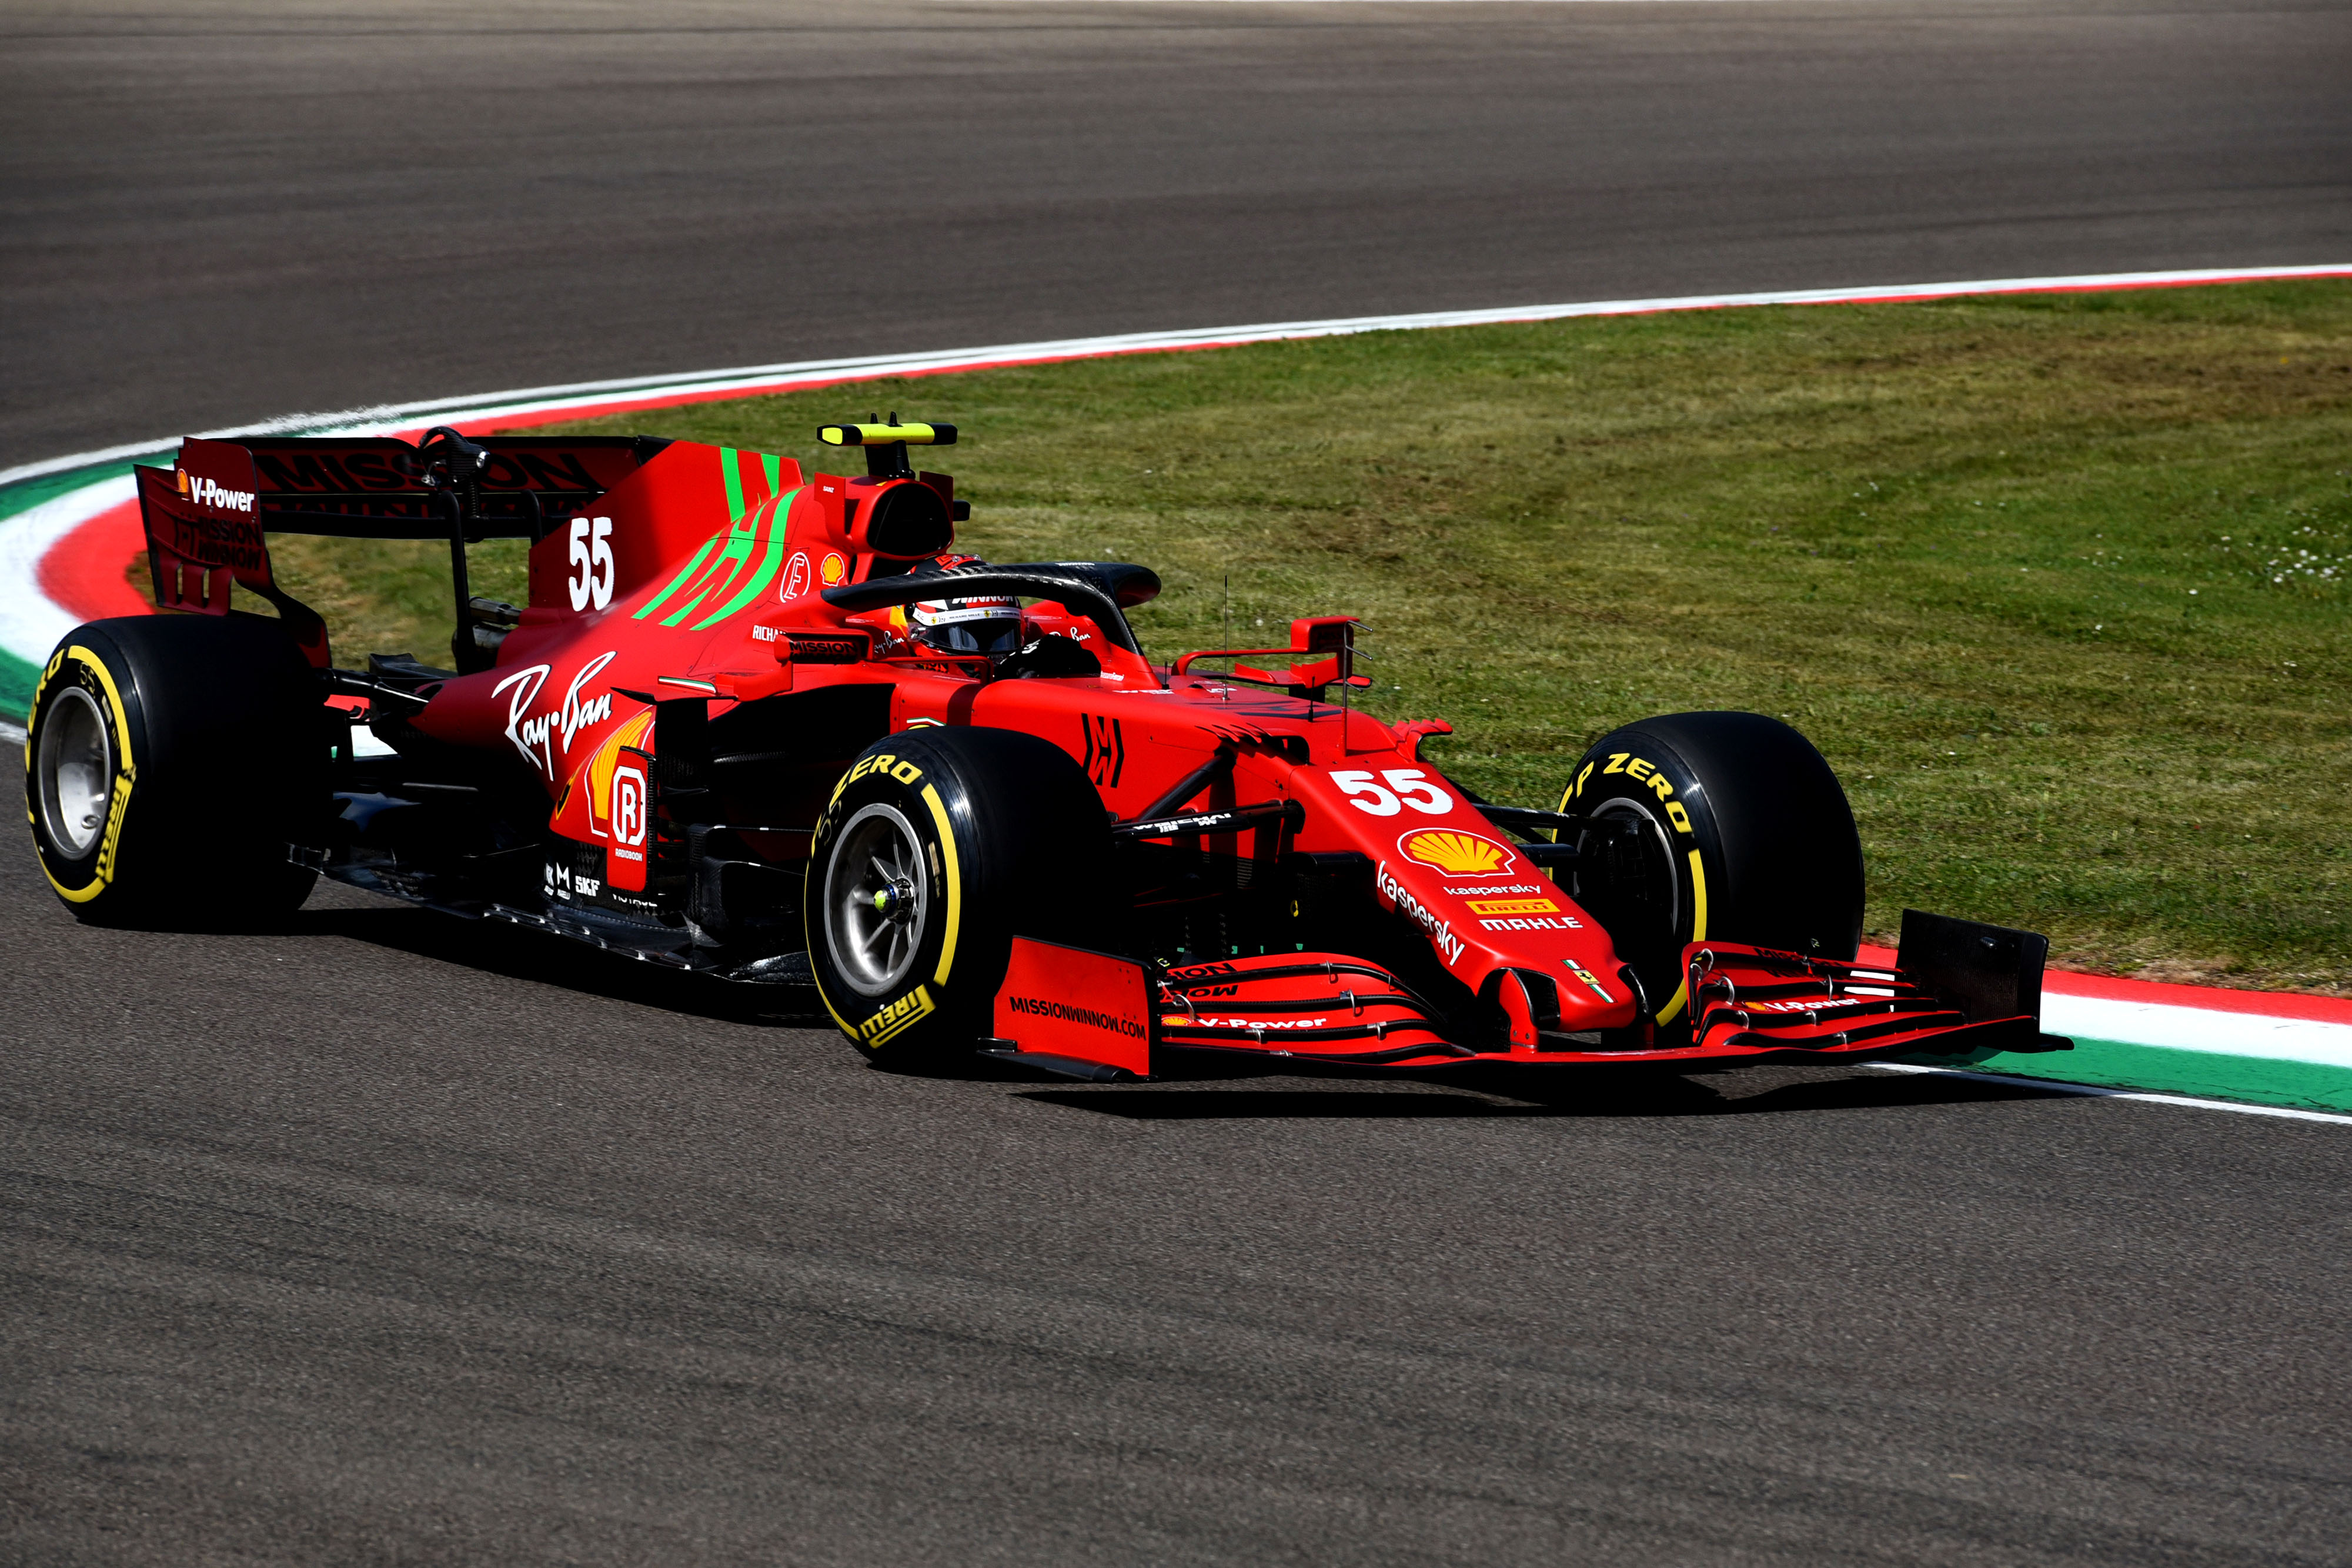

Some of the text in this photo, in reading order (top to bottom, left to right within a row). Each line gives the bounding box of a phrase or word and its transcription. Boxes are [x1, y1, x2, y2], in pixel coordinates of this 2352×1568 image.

[255, 453, 606, 492] MISSON
[189, 476, 255, 512] V-Power
[569, 516, 614, 611] 55
[752, 624, 786, 642] RICHA
[789, 640, 857, 654] MISSION
[828, 754, 923, 815] ZERO
[1328, 769, 1454, 817] 55
[1603, 752, 1694, 833] ZERO
[615, 848, 643, 861] RADIOBOOK
[575, 875, 600, 897] SKF
[1442, 884, 1541, 895] kaspersky
[1377, 860, 1465, 966] kaspersky
[1475, 901, 1549, 912] PIRELLI
[1478, 917, 1583, 931] MAHLE
[859, 984, 936, 1049] PIRELLI
[1009, 996, 1147, 1041] MISSIONWINNOW.COM
[1763, 998, 1862, 1012] V-Power
[1197, 1017, 1327, 1028] V-Power
